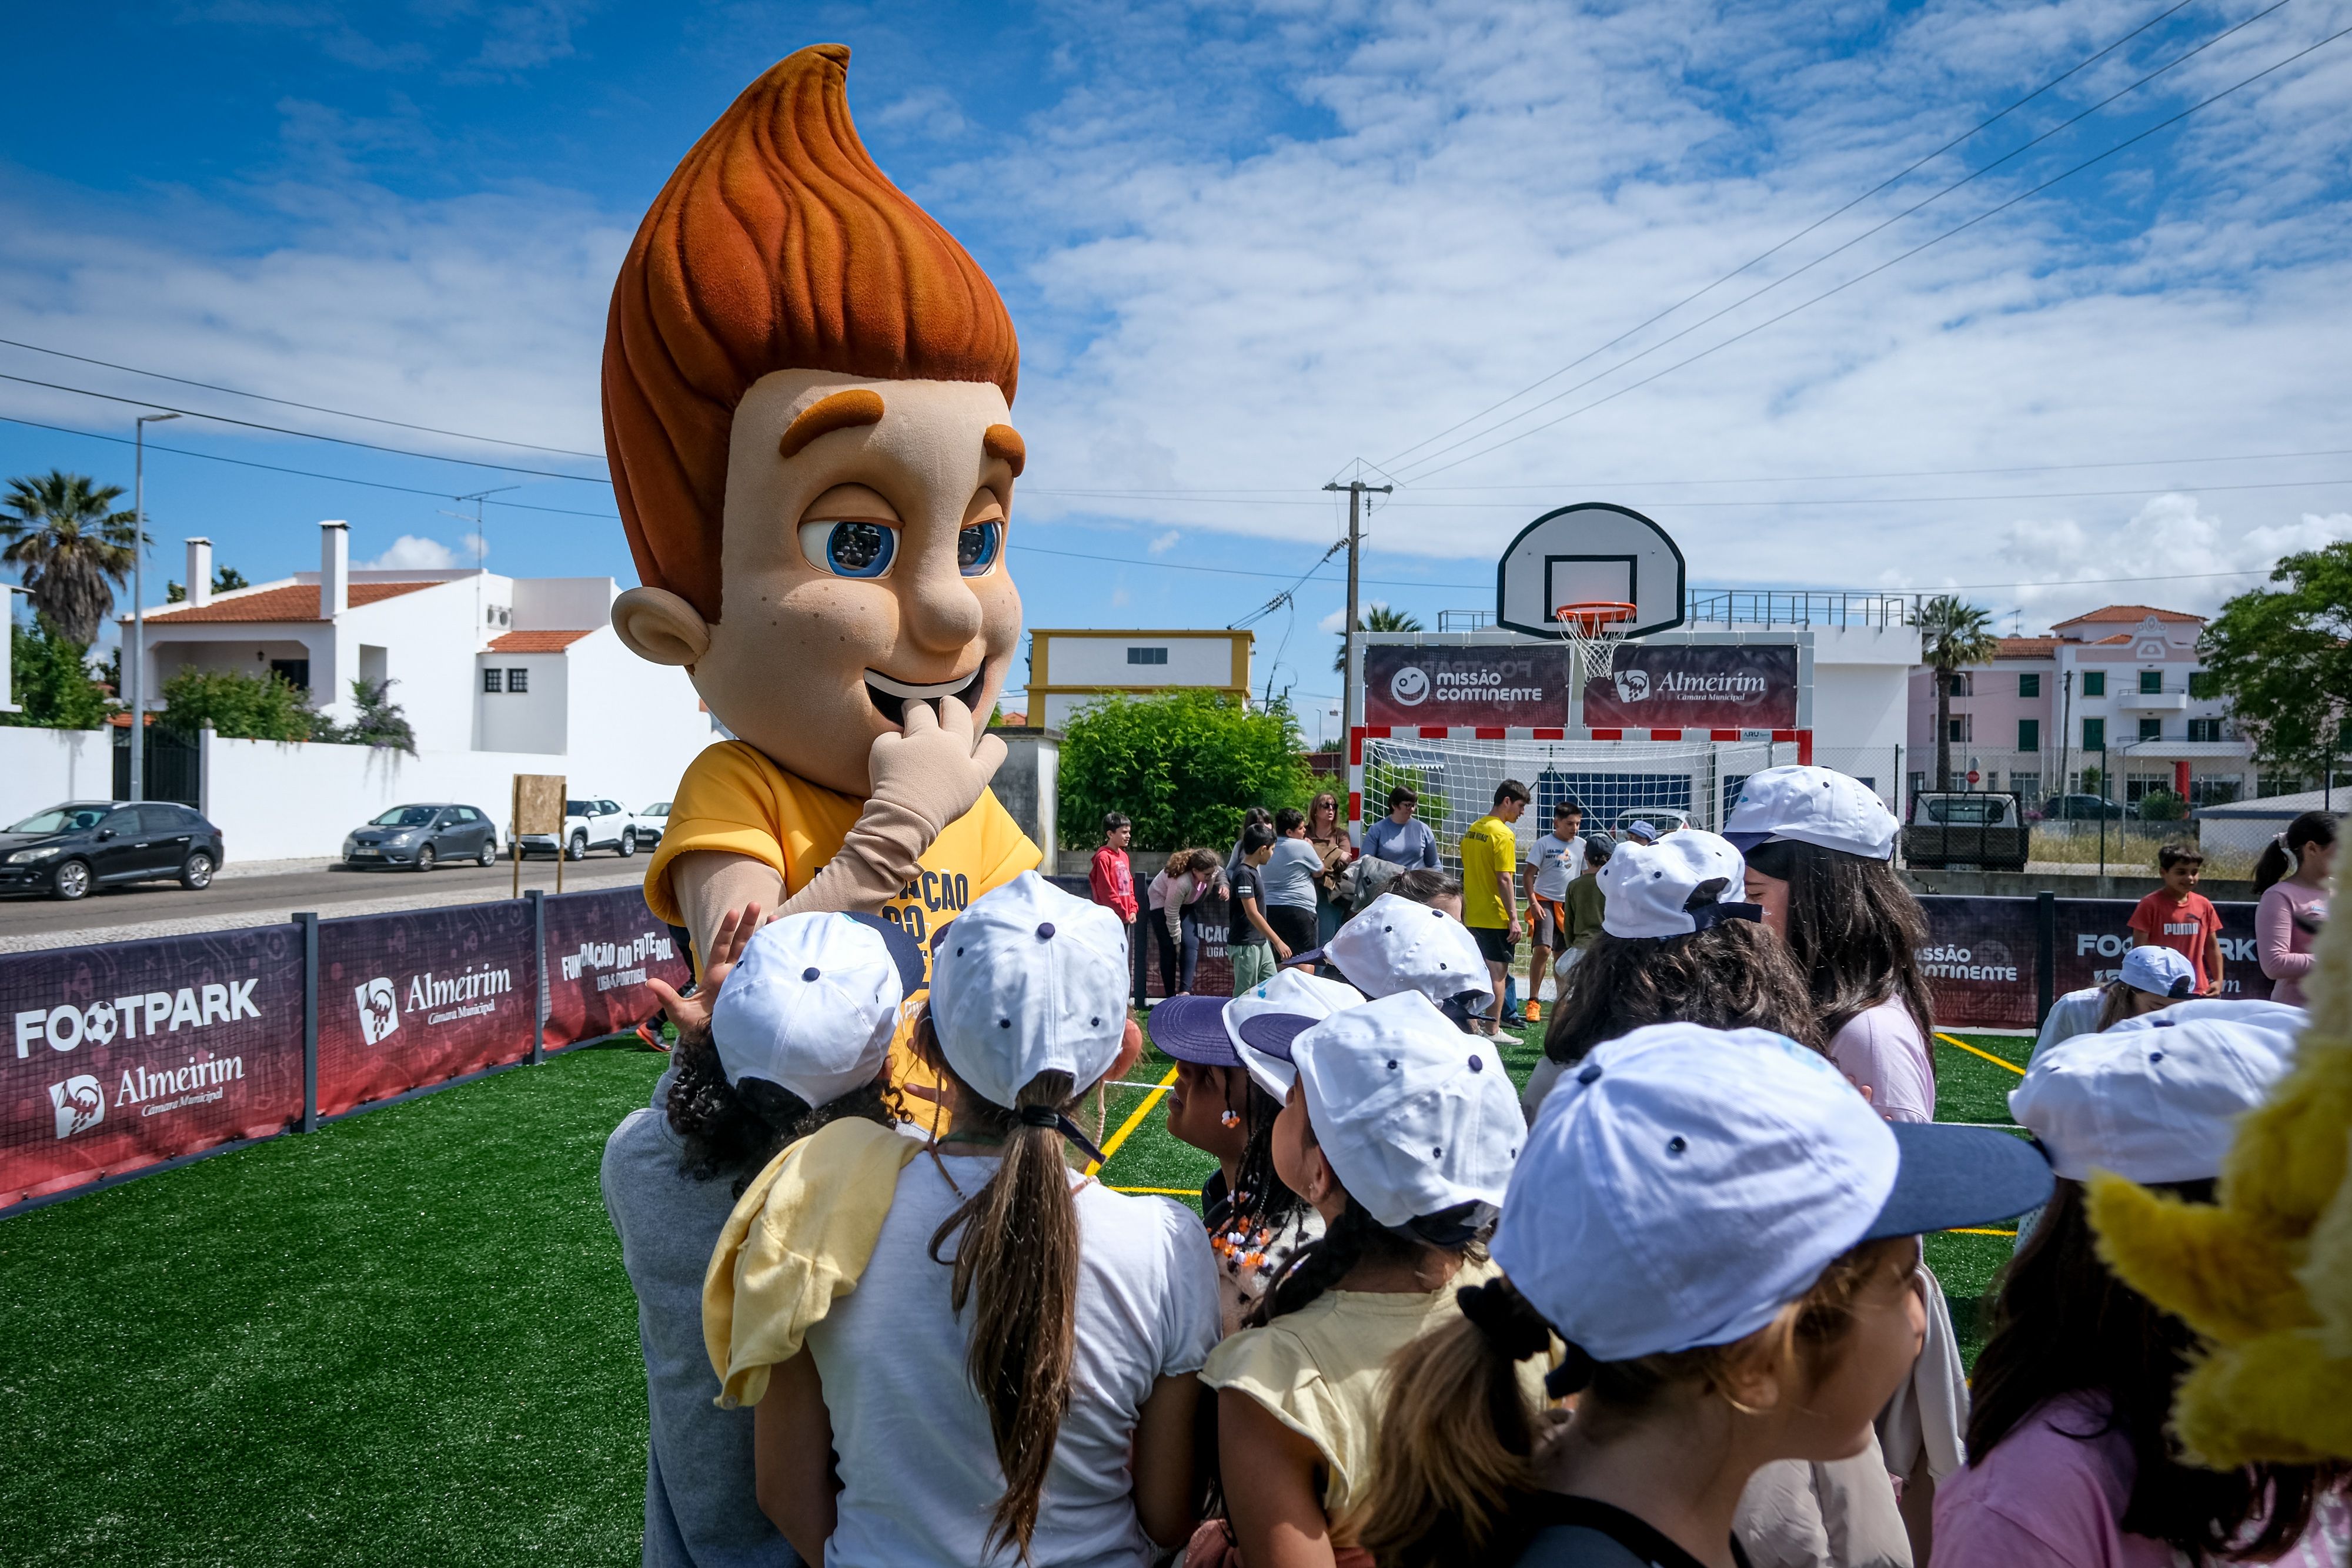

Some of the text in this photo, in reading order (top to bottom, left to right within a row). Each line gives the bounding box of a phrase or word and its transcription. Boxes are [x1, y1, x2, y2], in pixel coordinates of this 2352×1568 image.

[1436, 669, 1501, 686] MISSÃO
[1656, 671, 1766, 691] Almeirim
[1436, 688, 1542, 701] CONTINENTE
[1708, 693, 1745, 702] Municipal
[2163, 922, 2199, 935] PUMA
[561, 932, 674, 981] FUNDAÇÃO DO FUTEBOL
[1207, 947, 1224, 957] LIGA
[405, 963, 513, 1013] Almeirim
[597, 974, 612, 991] LIGA
[15, 978, 262, 1058] FOOTPARK
[457, 998, 496, 1018] Municipal
[113, 1052, 246, 1107] Almeirim
[179, 1086, 223, 1107] Municipal
